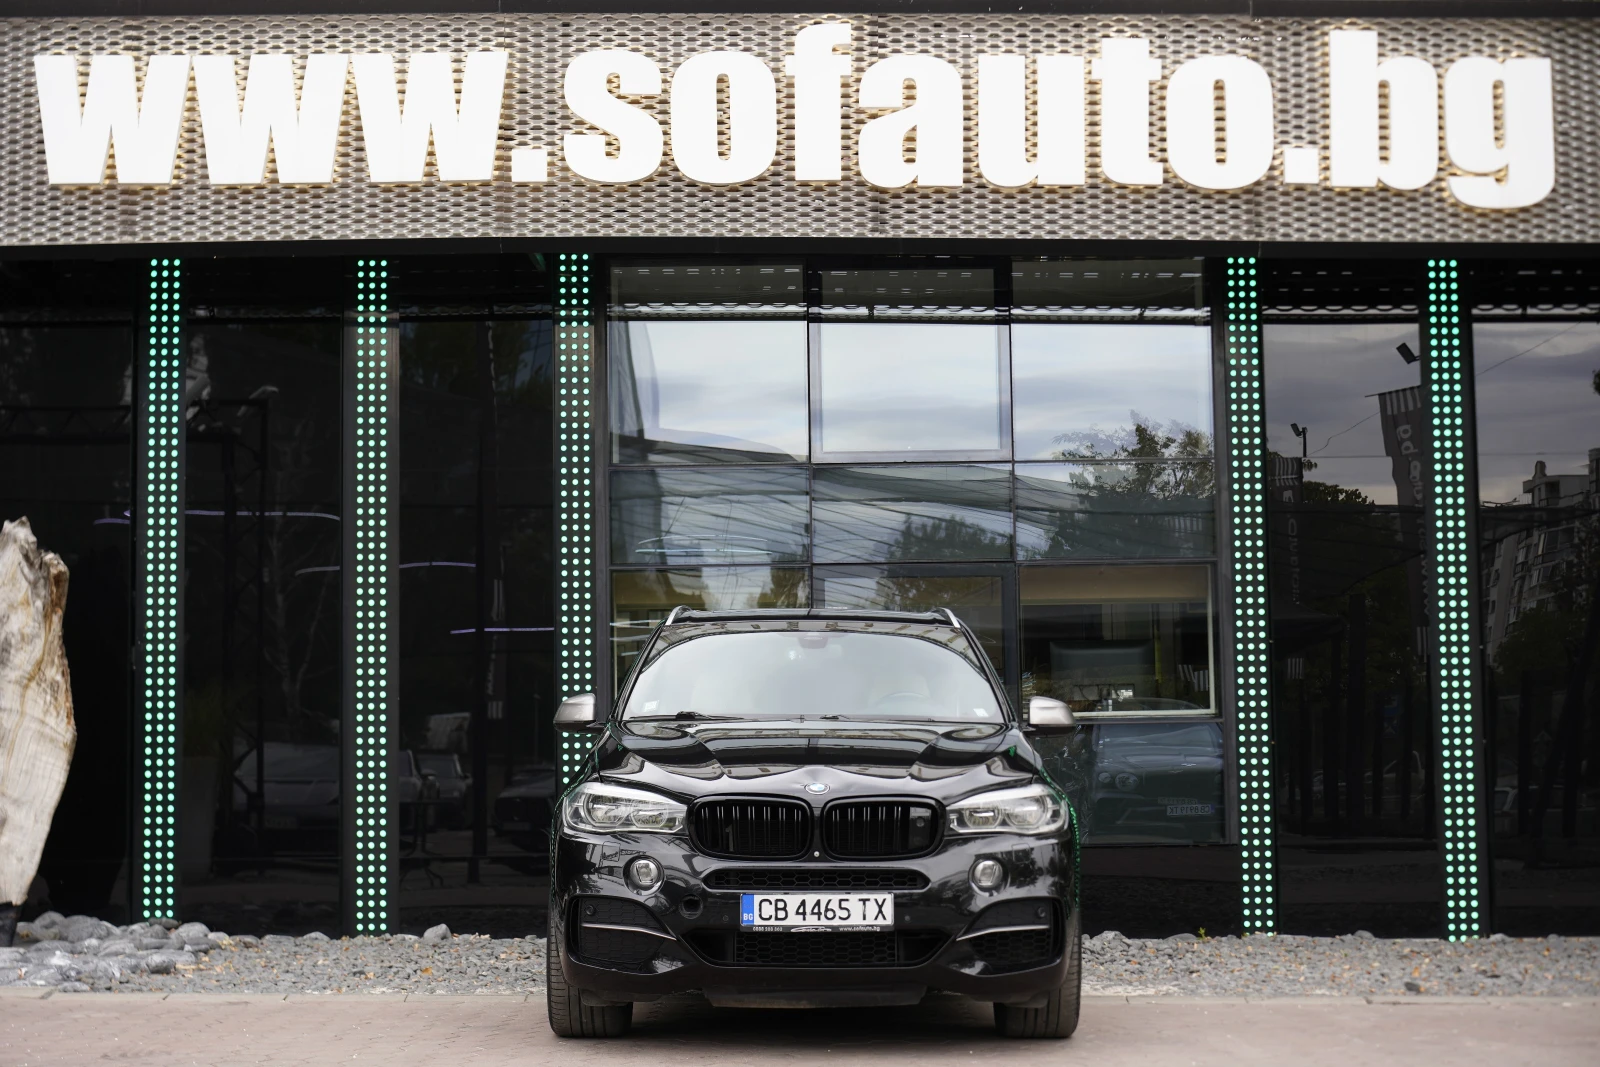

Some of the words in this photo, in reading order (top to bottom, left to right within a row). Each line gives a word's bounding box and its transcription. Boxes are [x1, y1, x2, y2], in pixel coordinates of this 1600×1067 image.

[34, 23, 1555, 208] www.sofauto.bg
[743, 913, 754, 921] BG
[758, 898, 789, 921] CB
[794, 898, 851, 921] 4465
[858, 898, 887, 921] TX
